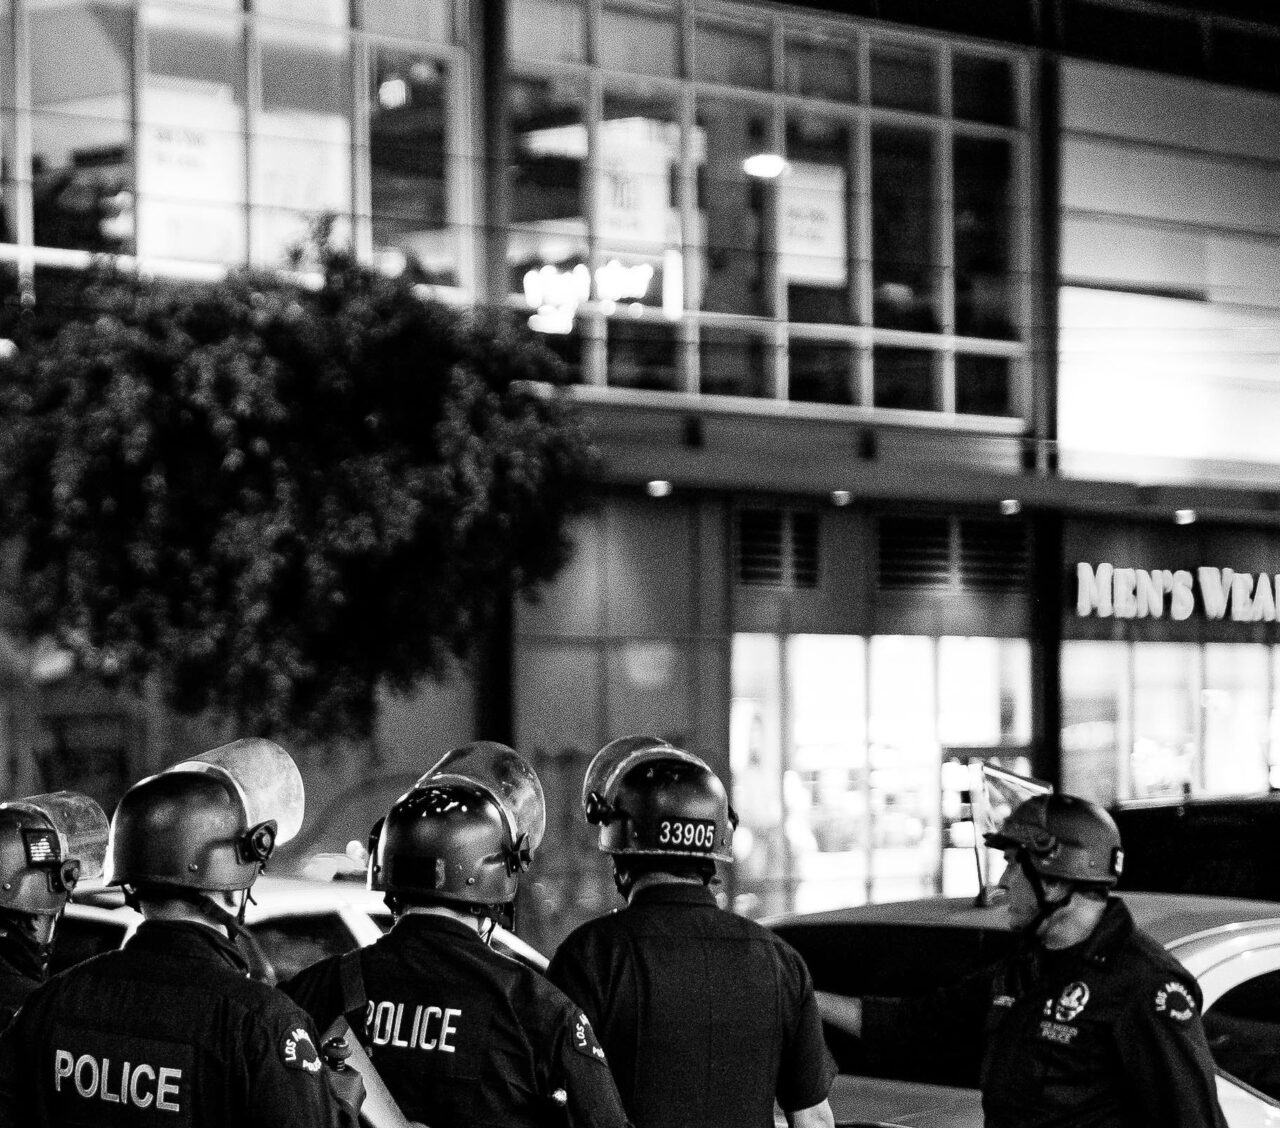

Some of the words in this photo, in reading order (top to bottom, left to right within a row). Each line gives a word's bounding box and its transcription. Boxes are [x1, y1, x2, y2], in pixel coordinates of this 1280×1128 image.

[1077, 562, 1195, 620] MEN'S
[660, 821, 715, 847] 33905
[285, 1039, 297, 1061] LOS
[55, 1049, 182, 1112] POLICE
